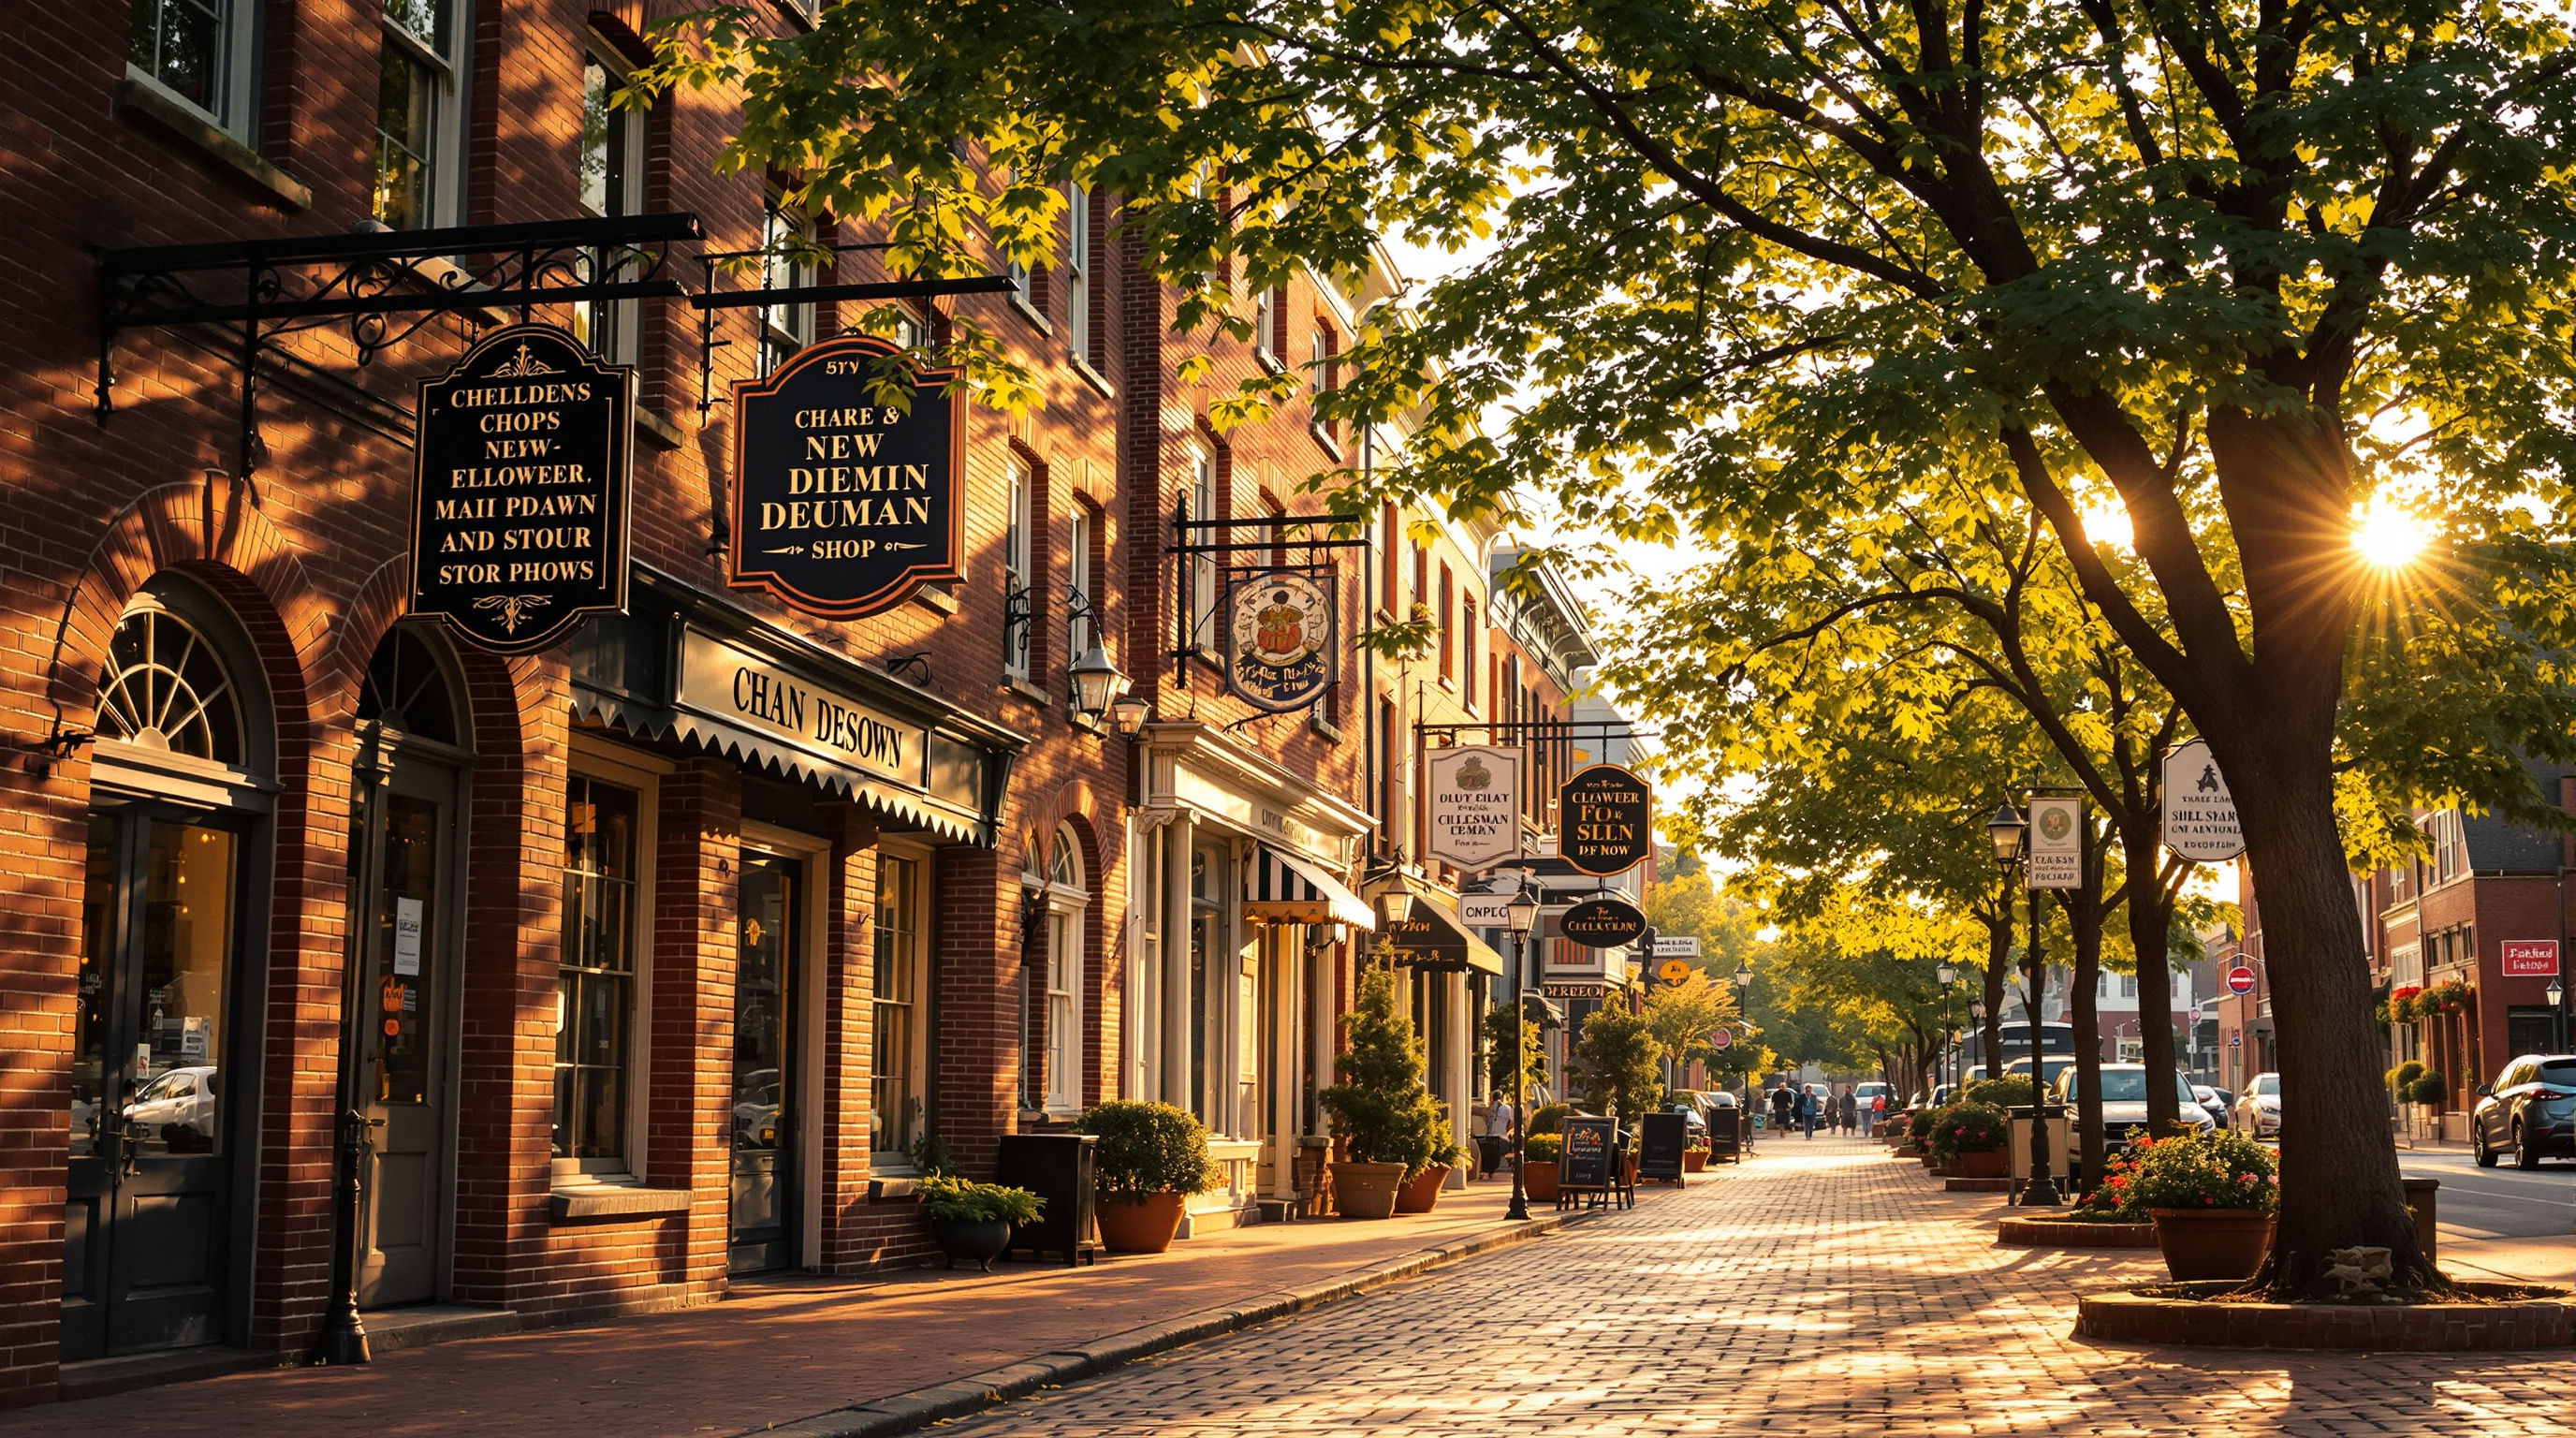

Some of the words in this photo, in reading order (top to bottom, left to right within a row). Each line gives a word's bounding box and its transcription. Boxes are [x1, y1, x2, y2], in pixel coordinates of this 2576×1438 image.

[451, 382, 591, 408] CHELLDENS
[480, 410, 561, 433] CHOPS
[795, 407, 874, 429] CHARE
[883, 406, 900, 425] &
[806, 433, 885, 461] NEW
[789, 464, 929, 494] DIEMIN
[505, 494, 597, 517] PDAWN
[759, 496, 931, 531] DEUMAN
[439, 531, 495, 552] AND
[504, 526, 592, 550] STOUR
[812, 539, 876, 560] SHOP
[439, 564, 502, 584] STOR
[508, 560, 594, 582] PHOWS
[733, 667, 806, 733] CHAN
[815, 697, 903, 769] DESOWN
